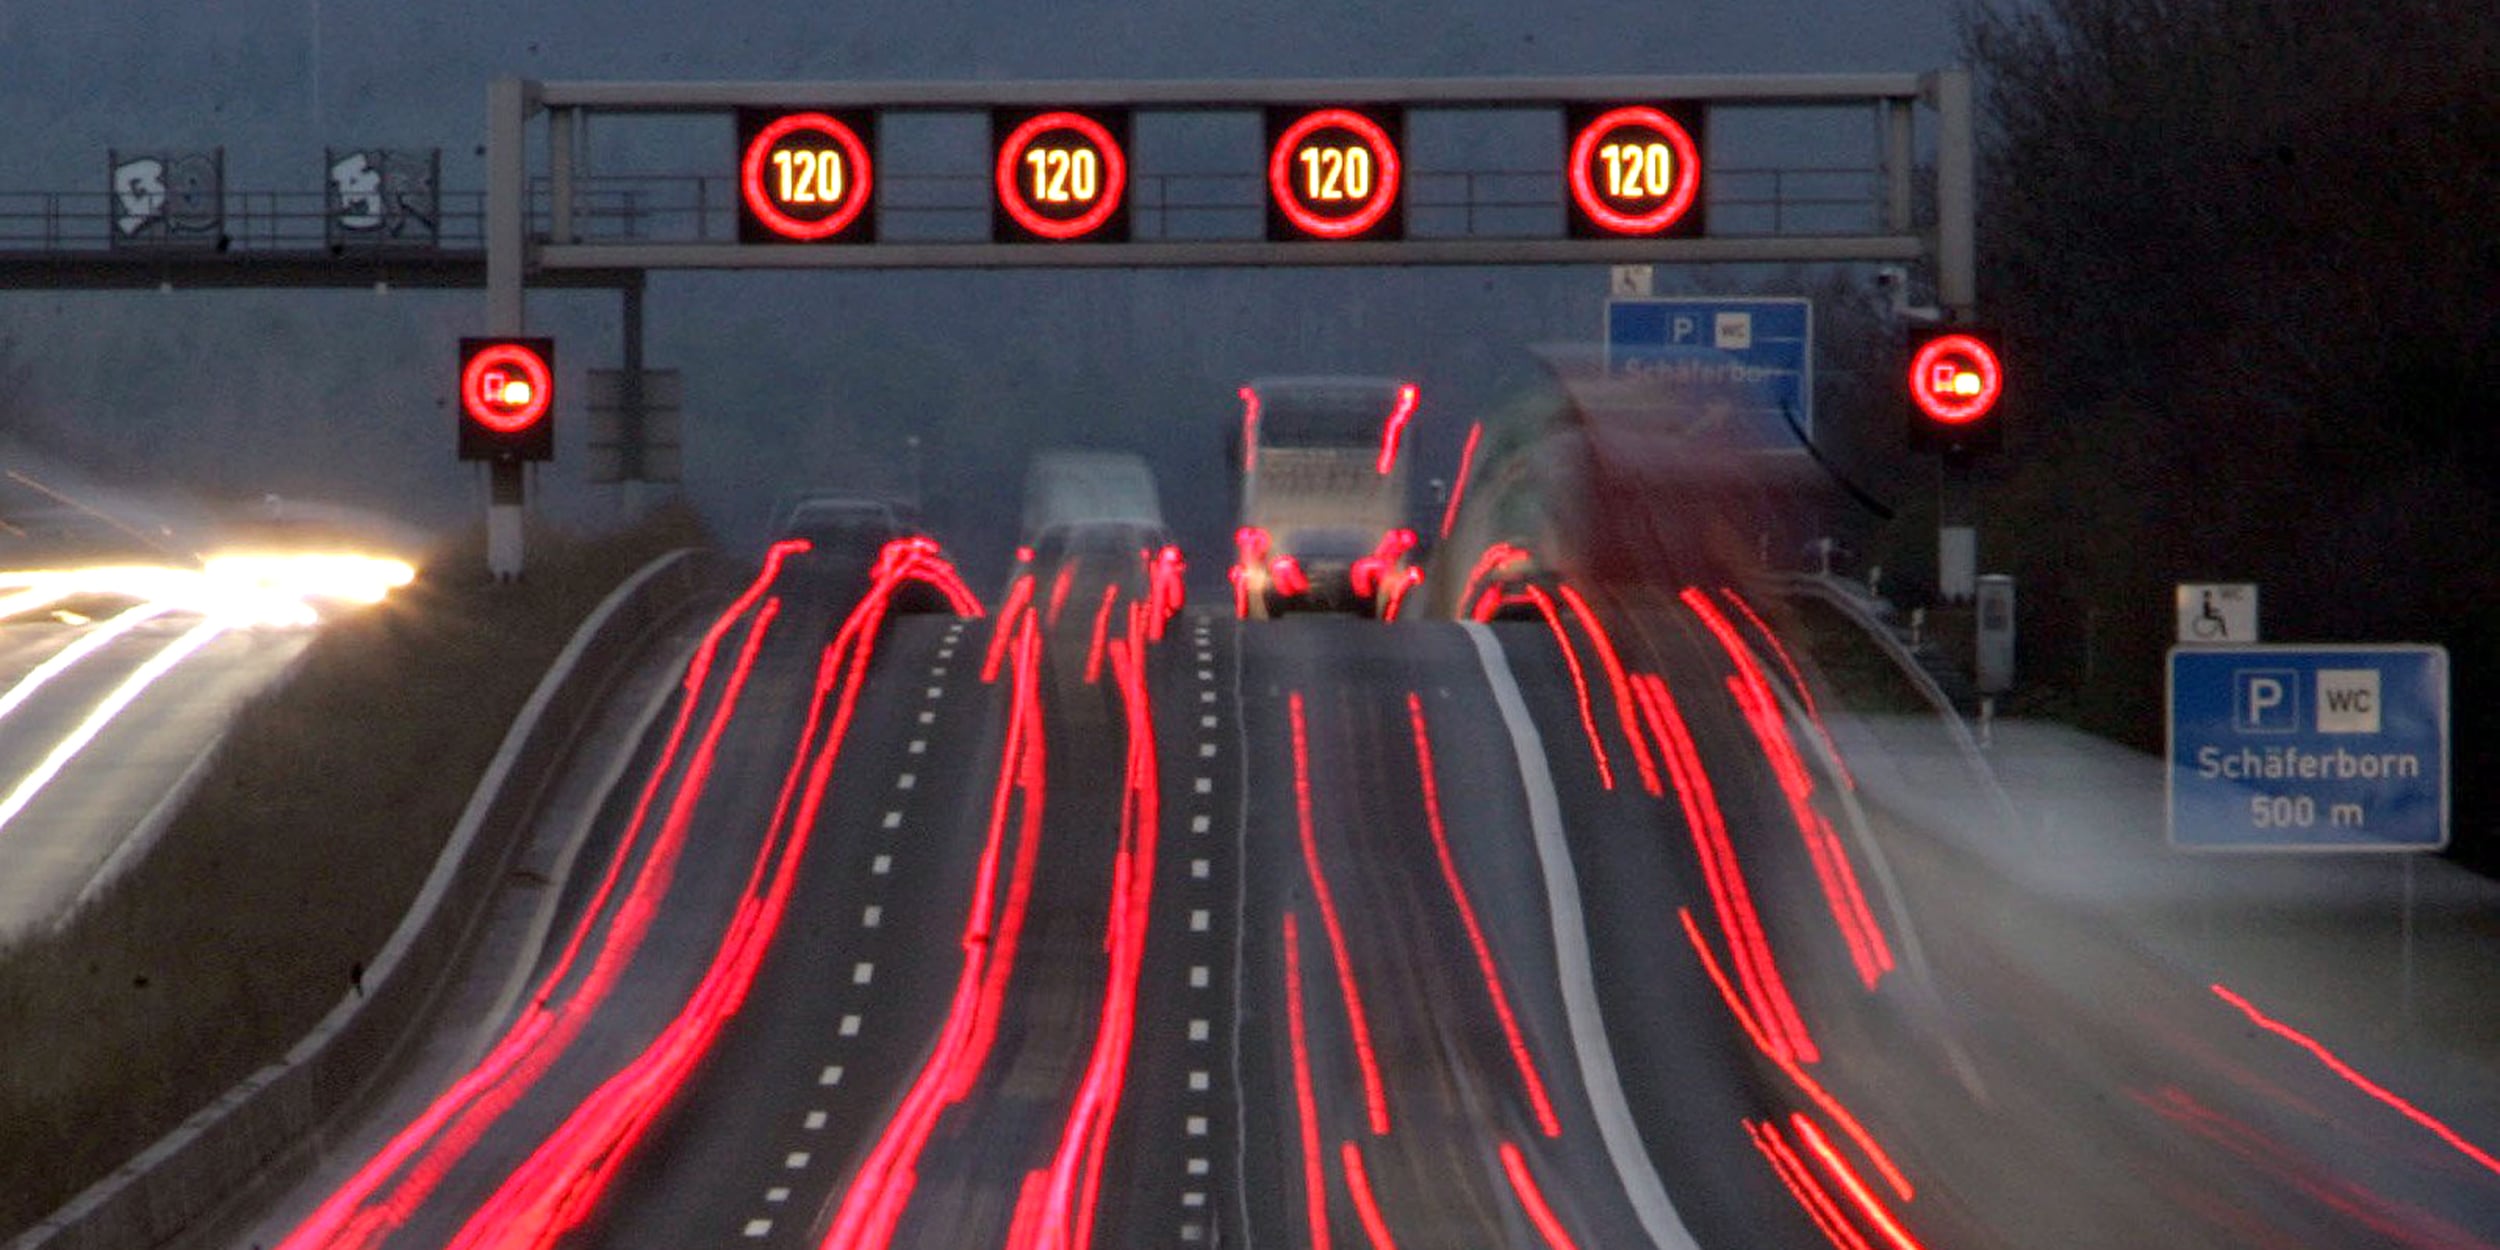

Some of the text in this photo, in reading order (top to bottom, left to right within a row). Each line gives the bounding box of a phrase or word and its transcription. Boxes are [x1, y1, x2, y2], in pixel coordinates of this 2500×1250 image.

[773, 149, 843, 202] 120
[1027, 148, 1096, 202] 120
[1301, 146, 1370, 200] 120
[1601, 143, 1671, 198] 120
[1673, 317, 1693, 342] P
[2249, 678, 2371, 724] P WC
[2199, 746, 2419, 779] Schäferborn
[2252, 795, 2363, 828] 500 m
